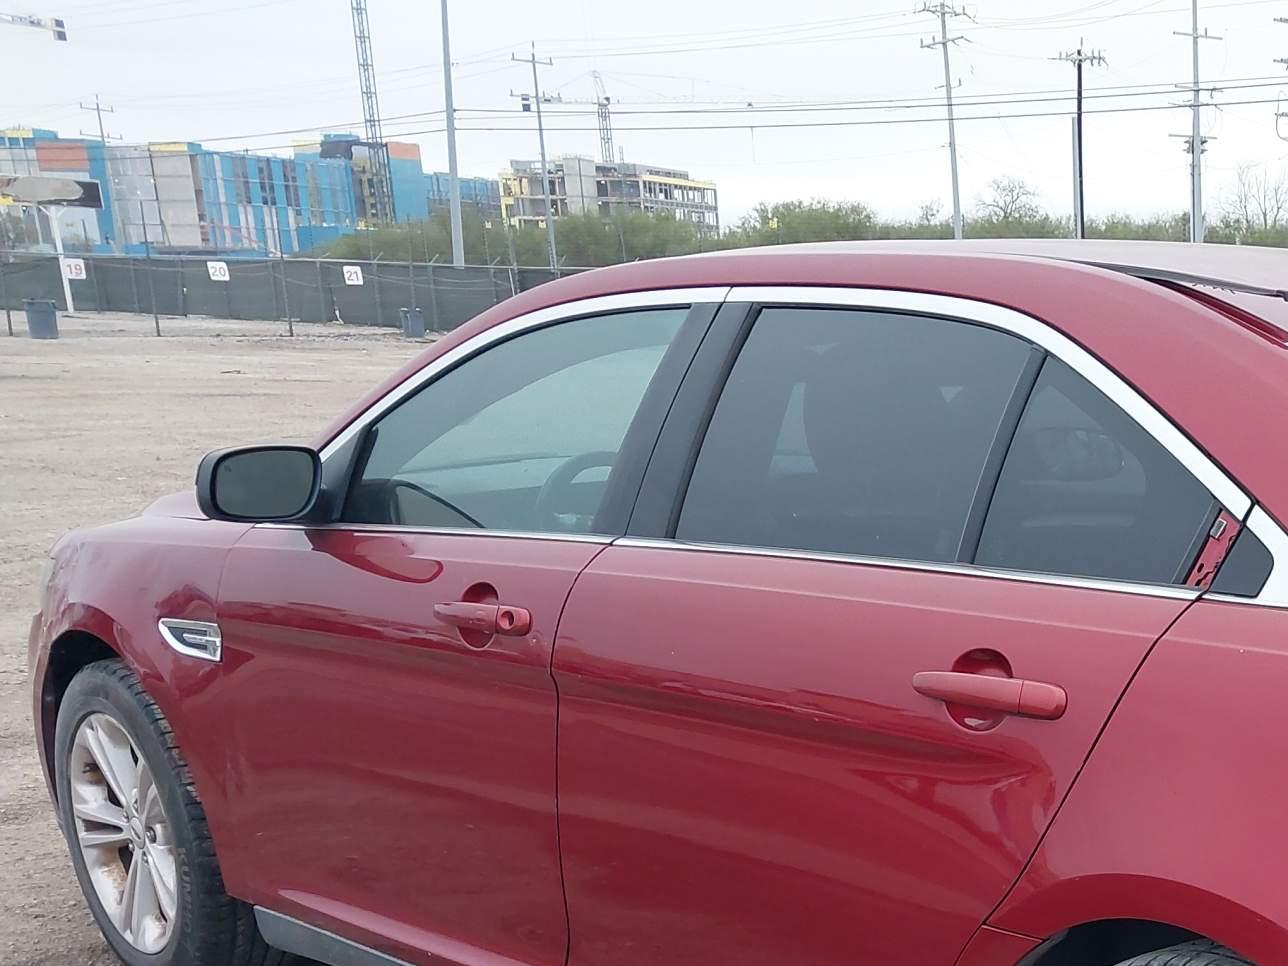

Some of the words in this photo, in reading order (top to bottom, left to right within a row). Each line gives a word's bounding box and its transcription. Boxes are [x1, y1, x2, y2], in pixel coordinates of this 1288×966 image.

[66, 263, 83, 277] 19
[210, 265, 227, 278] 20
[345, 269, 360, 282] 21
